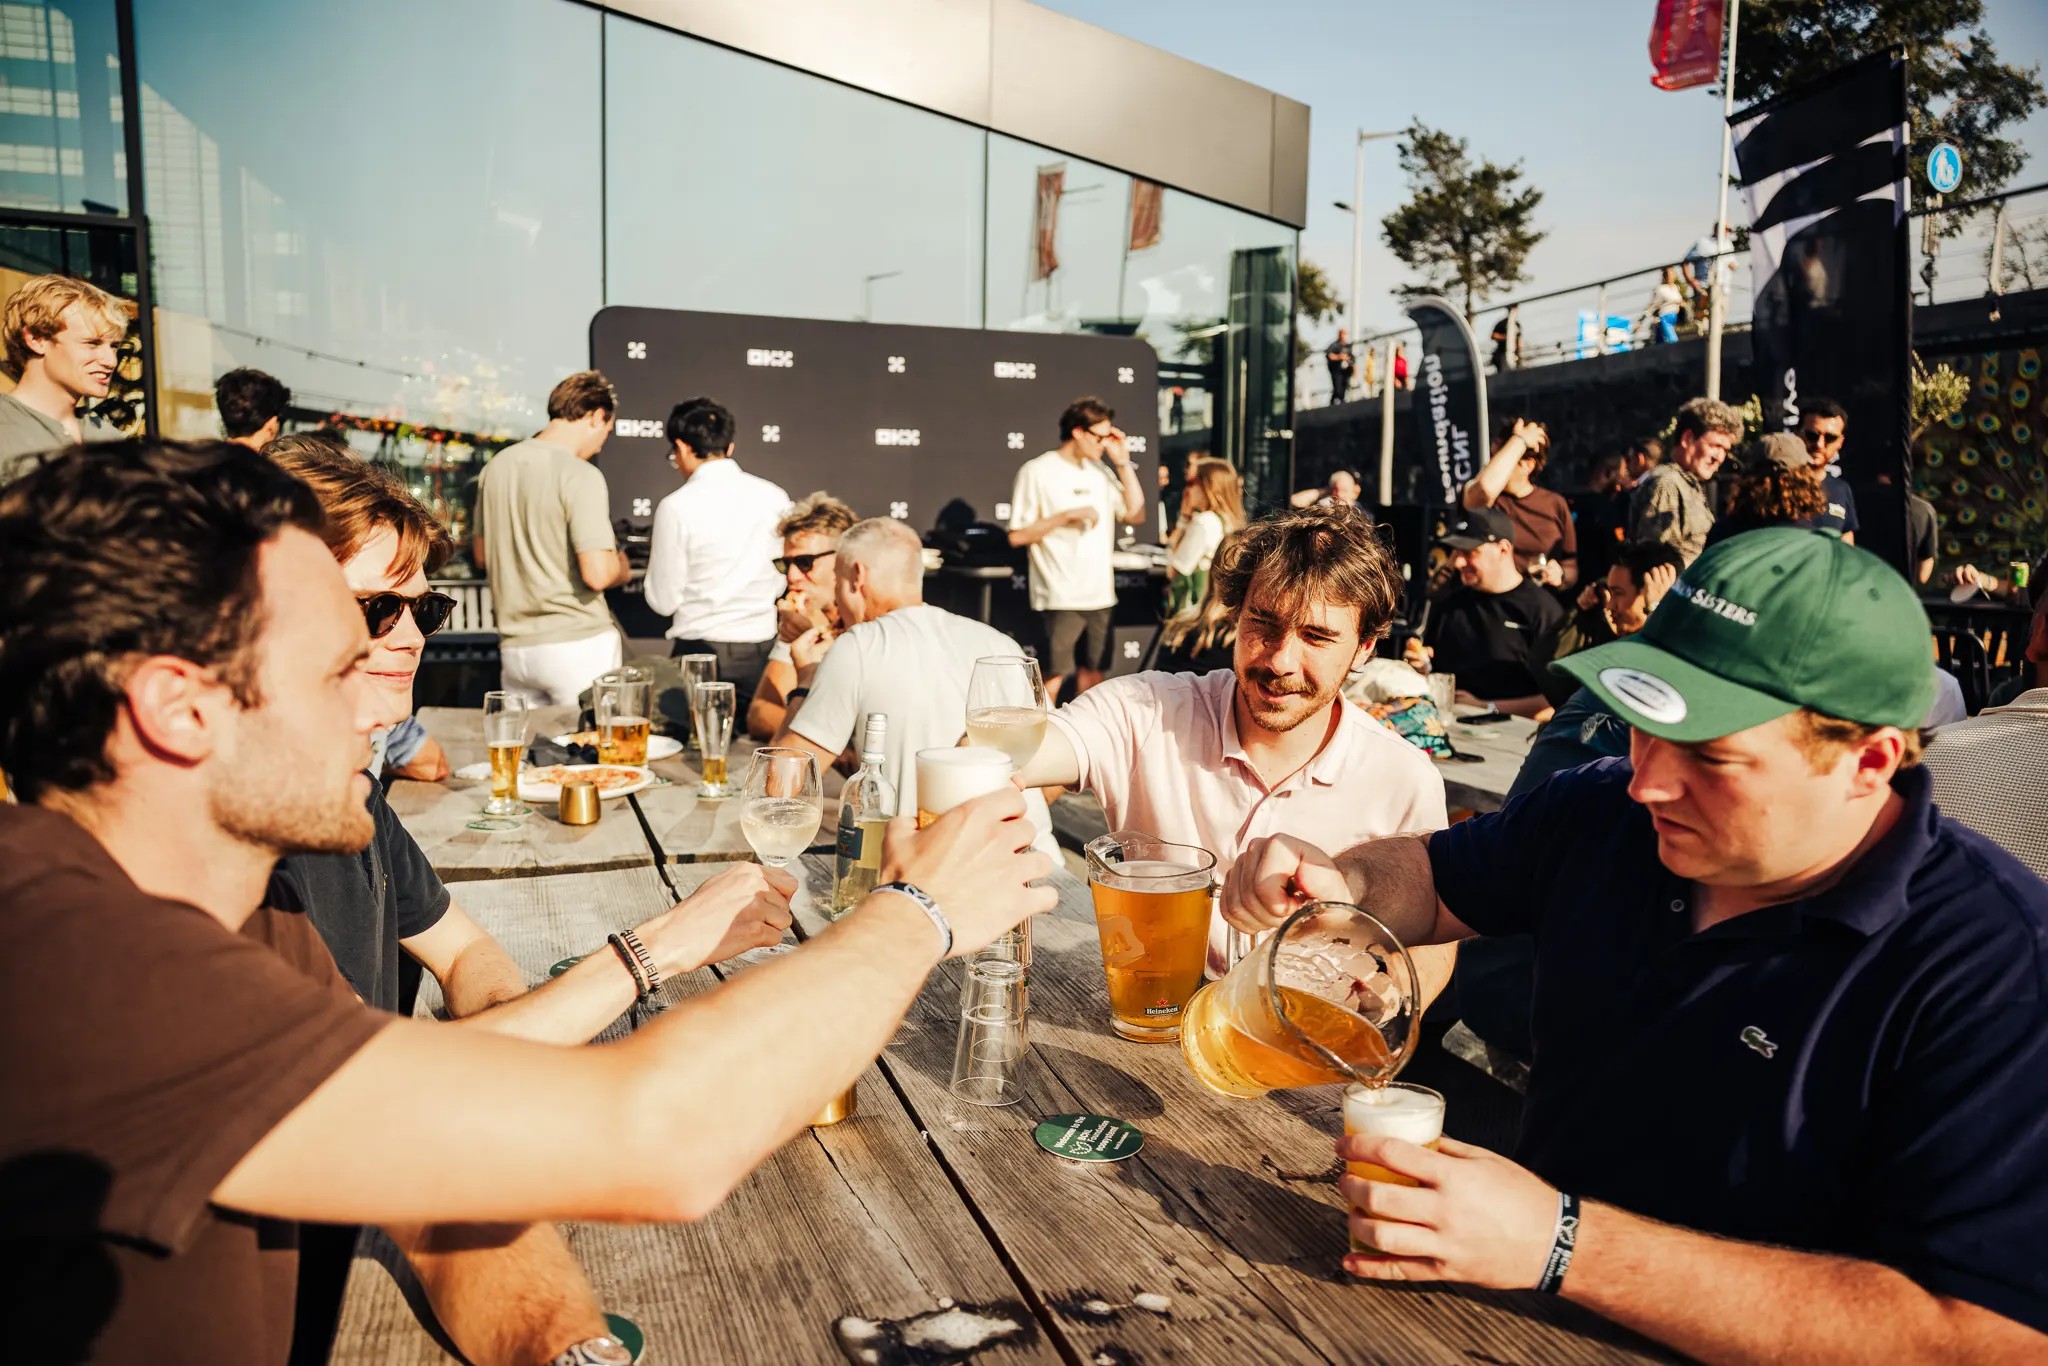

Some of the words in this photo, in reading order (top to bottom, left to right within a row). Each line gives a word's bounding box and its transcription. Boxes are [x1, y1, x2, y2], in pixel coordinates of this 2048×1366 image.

[1146, 1006, 1178, 1015] Heineken
[1054, 1128, 1077, 1148] Welcome
[1087, 1120, 1110, 1142] Foundation
